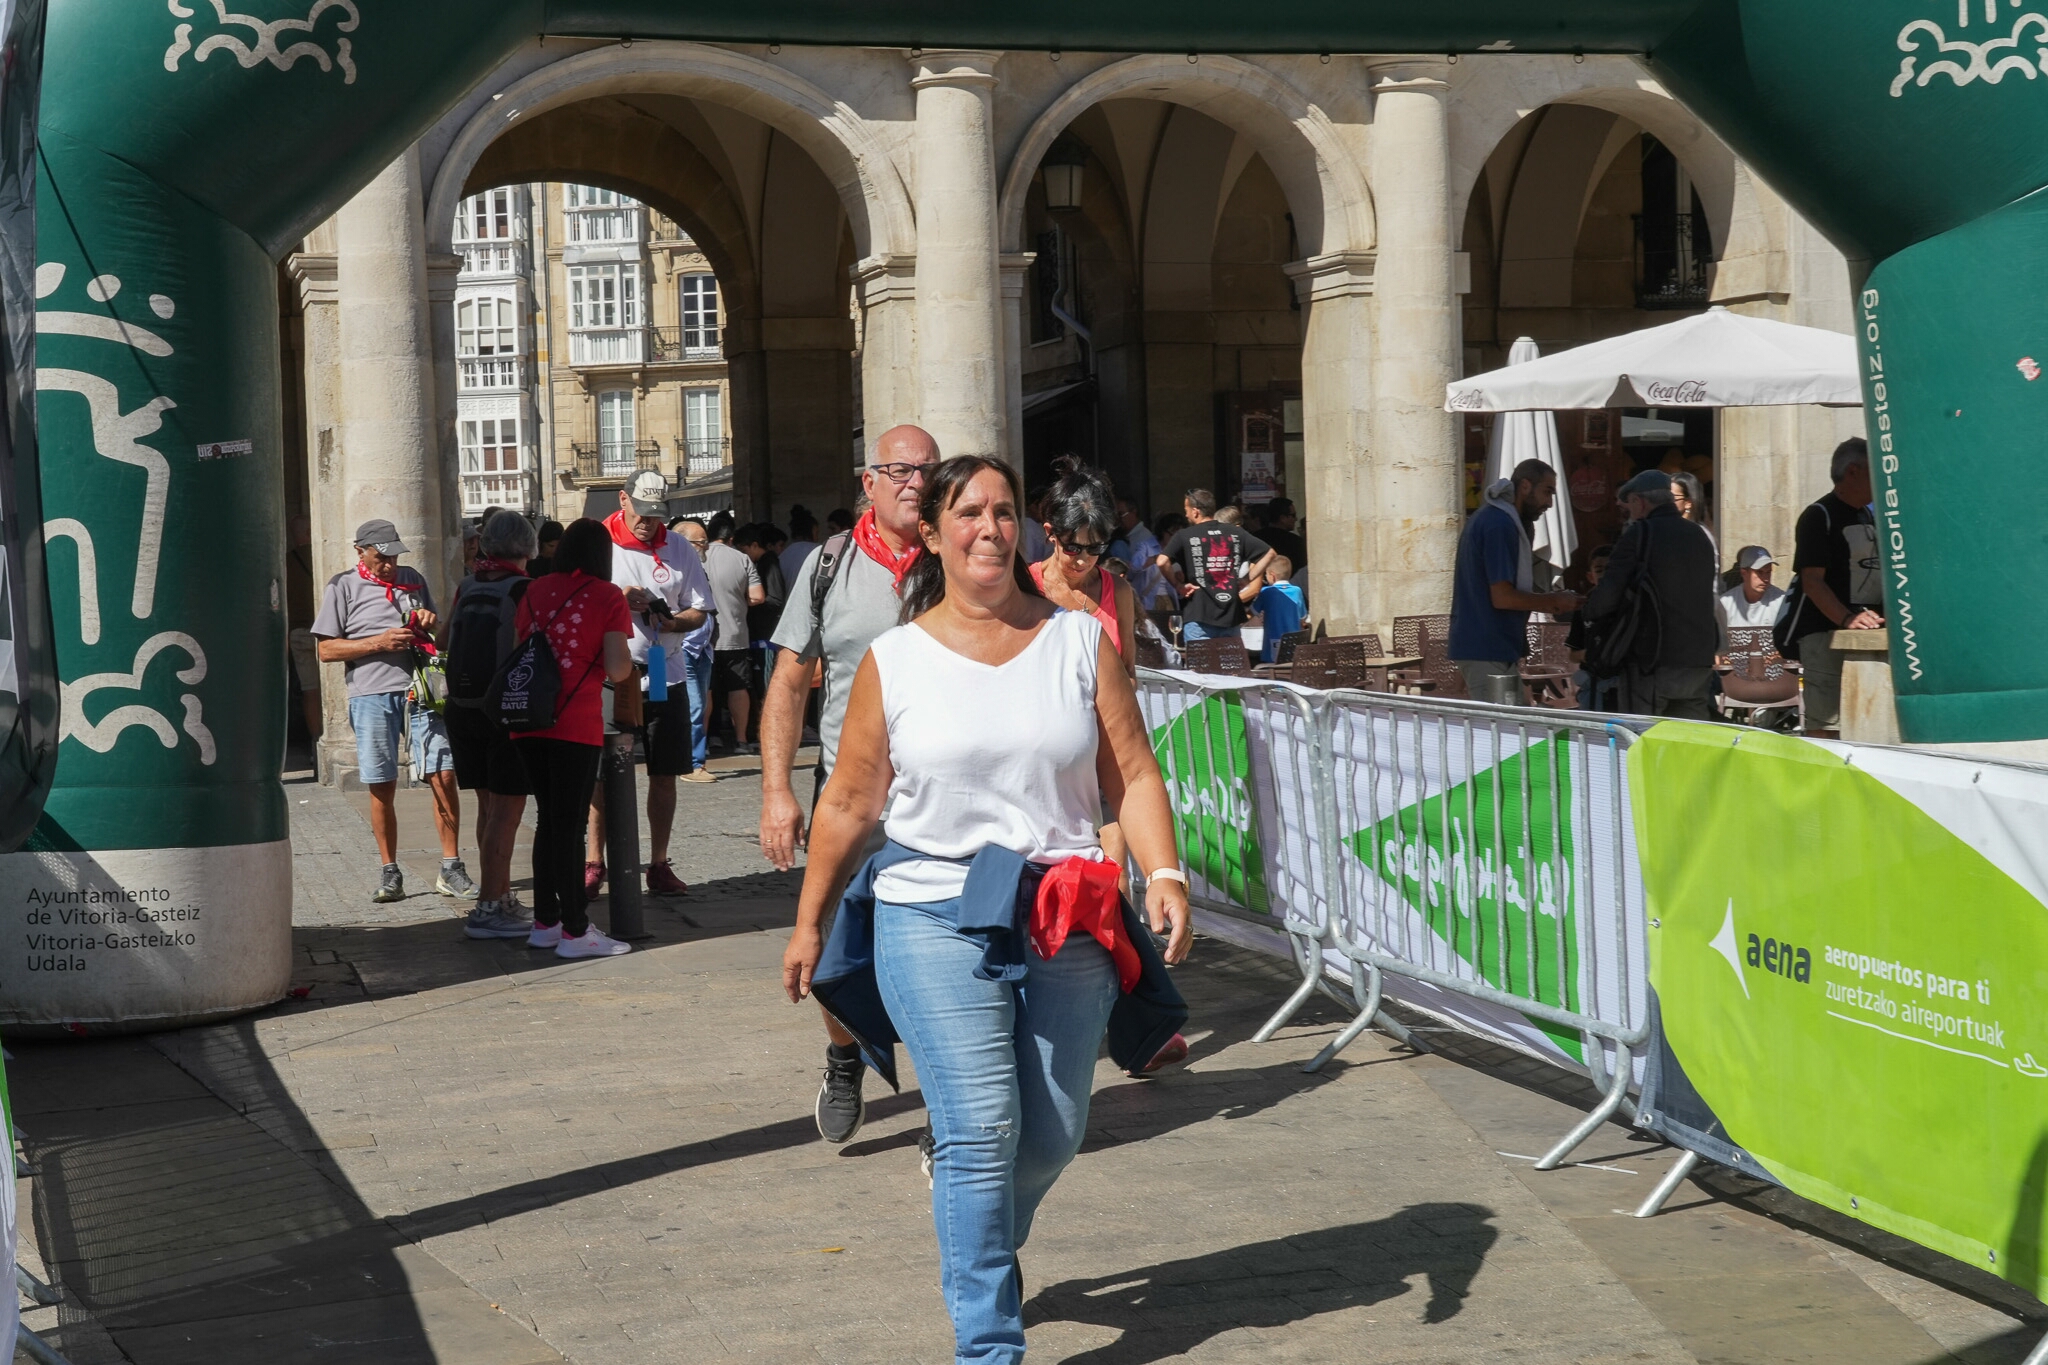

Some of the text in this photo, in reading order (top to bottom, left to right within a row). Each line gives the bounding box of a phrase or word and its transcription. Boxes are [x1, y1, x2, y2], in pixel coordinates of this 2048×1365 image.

[1647, 380, 1708, 403] Coca-Cola
[1863, 288, 1923, 681] www.vitoria-gasteiz.org
[501, 701, 528, 710] BATUZ
[26, 886, 170, 908] Ayuntamiento
[26, 904, 200, 925] de Vitoria-Gasteiz
[26, 930, 195, 950] Vitoria-Gasteizko
[27, 955, 86, 972] Udala
[1746, 932, 1811, 984] aena
[1824, 945, 1991, 1006] aeropuertos para ti
[1825, 980, 2005, 1049] zuretzako aireportuak
